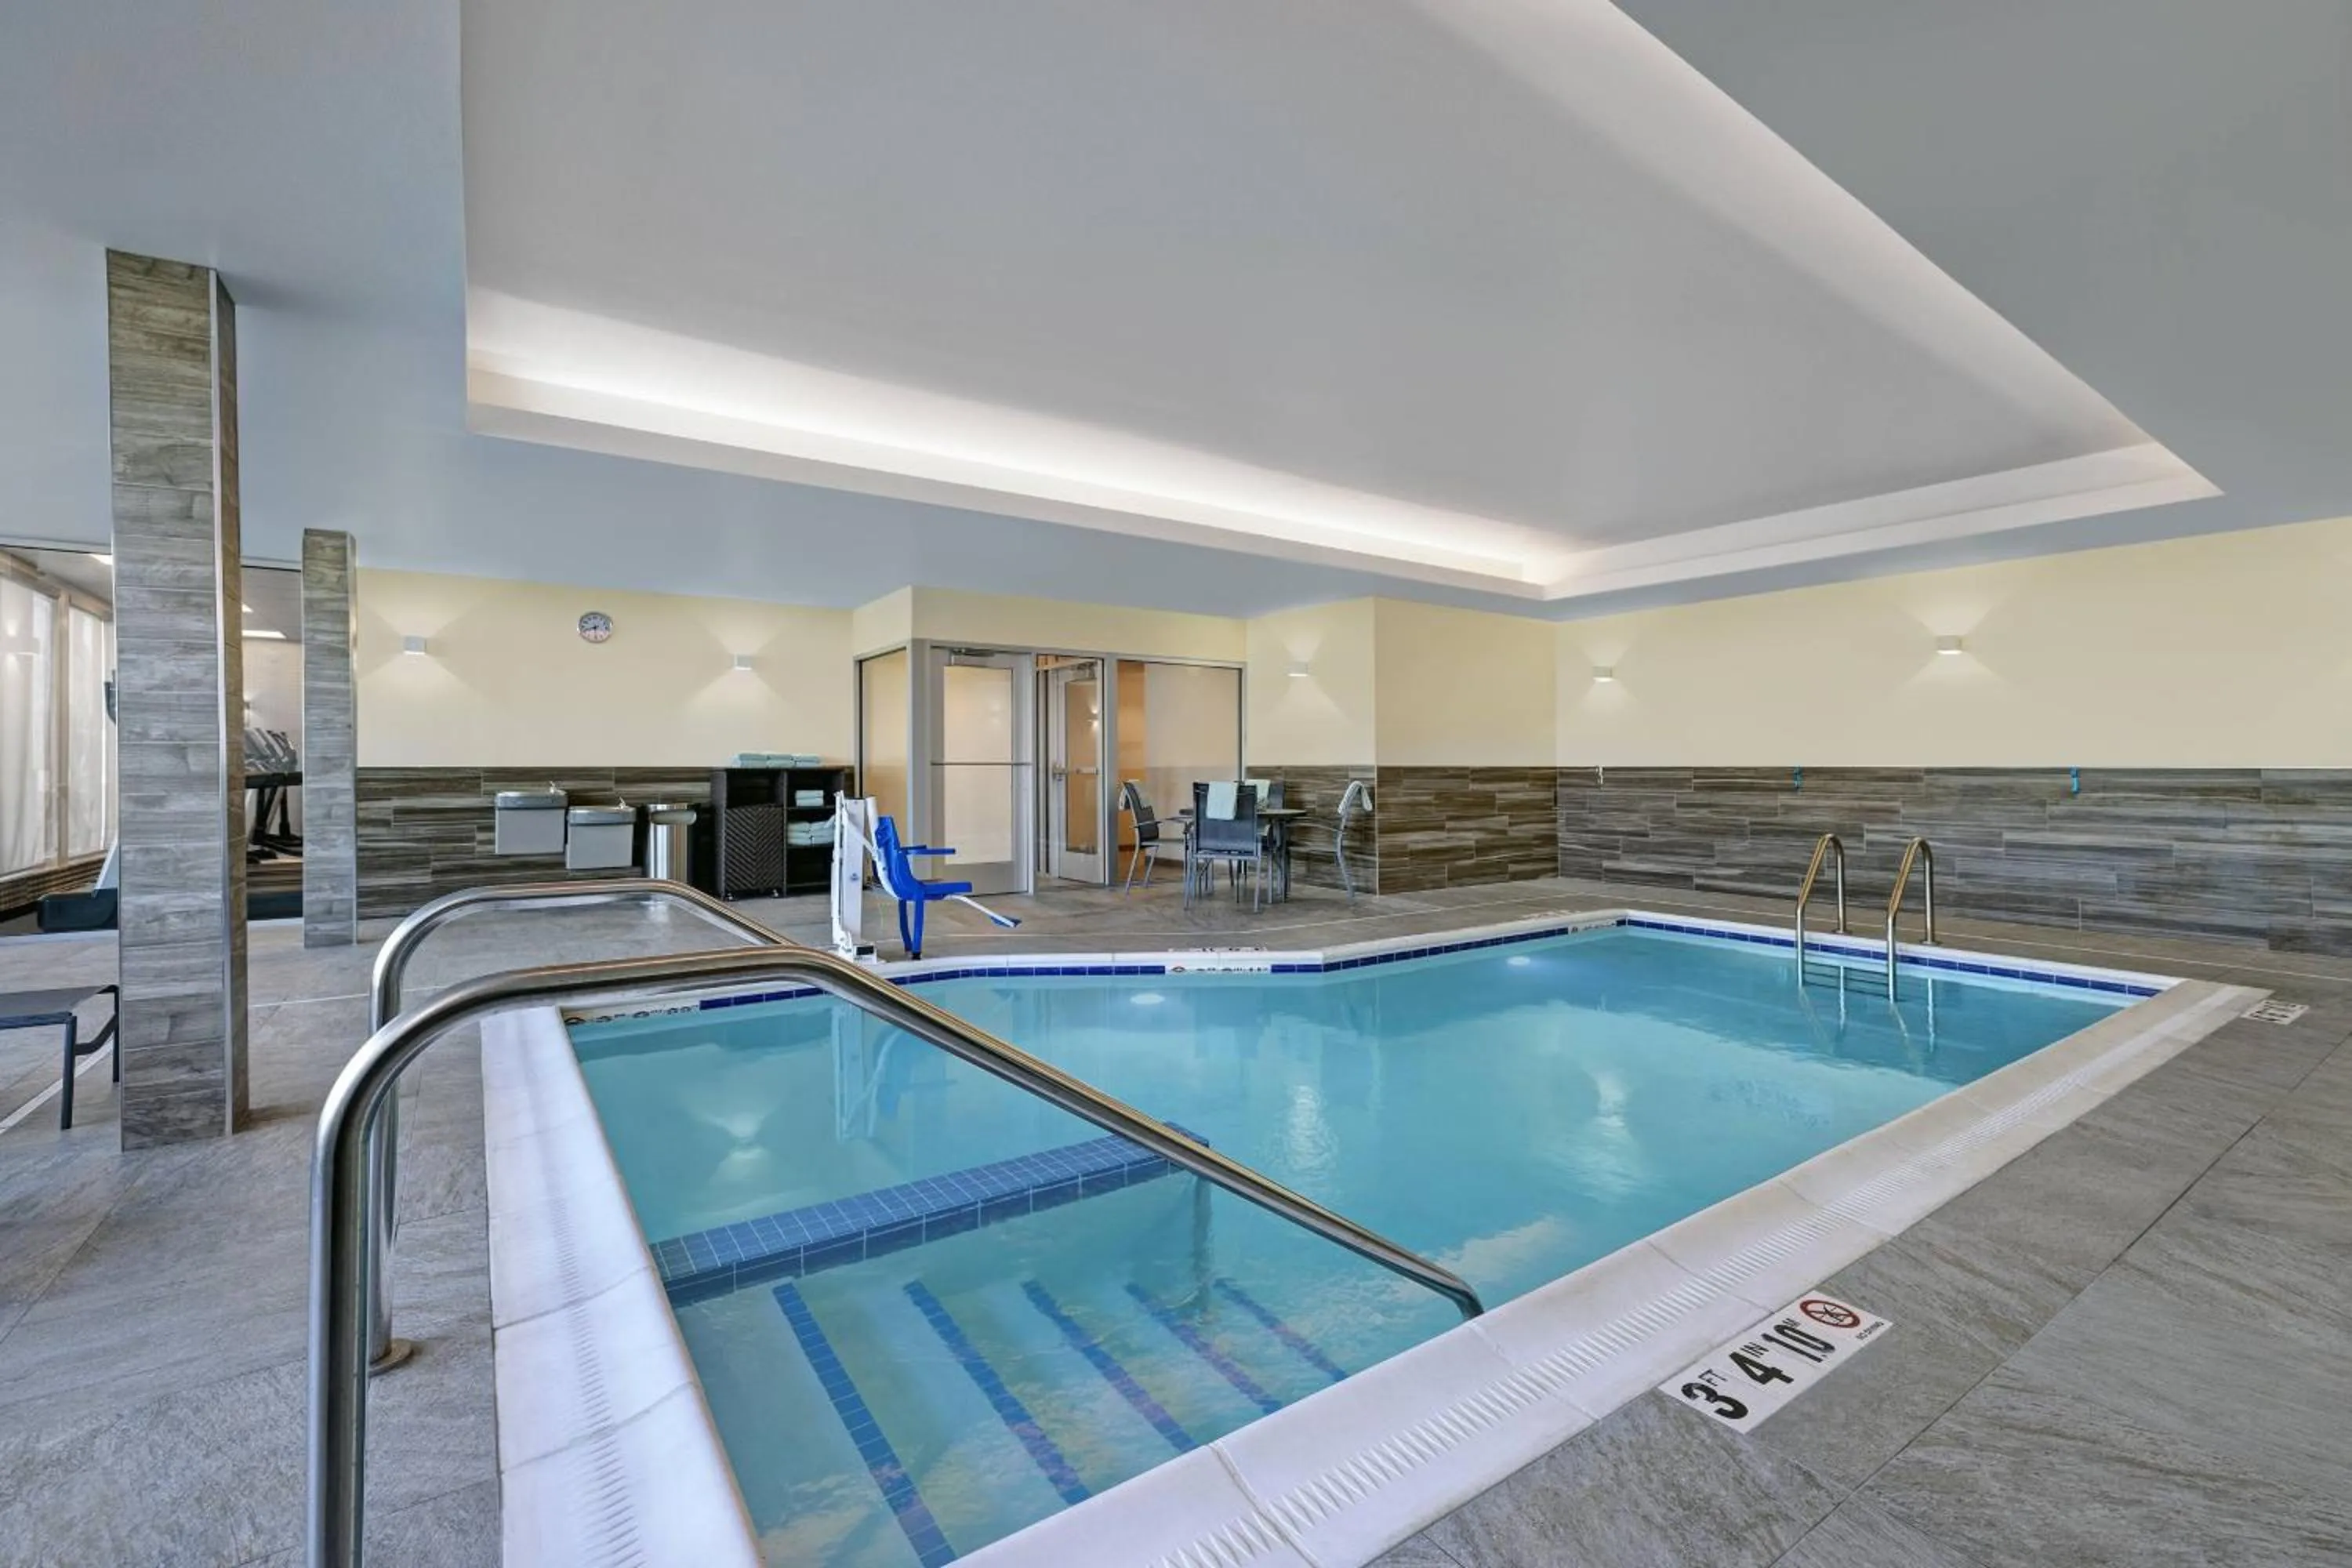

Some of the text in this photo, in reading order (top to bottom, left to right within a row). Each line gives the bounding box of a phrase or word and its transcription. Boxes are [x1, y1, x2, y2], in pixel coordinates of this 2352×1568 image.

[1739, 1341, 1769, 1359] IN
[1697, 1368, 1728, 1387] FT
[1729, 1352, 1795, 1385] 4
[1681, 1382, 1749, 1420] 3
